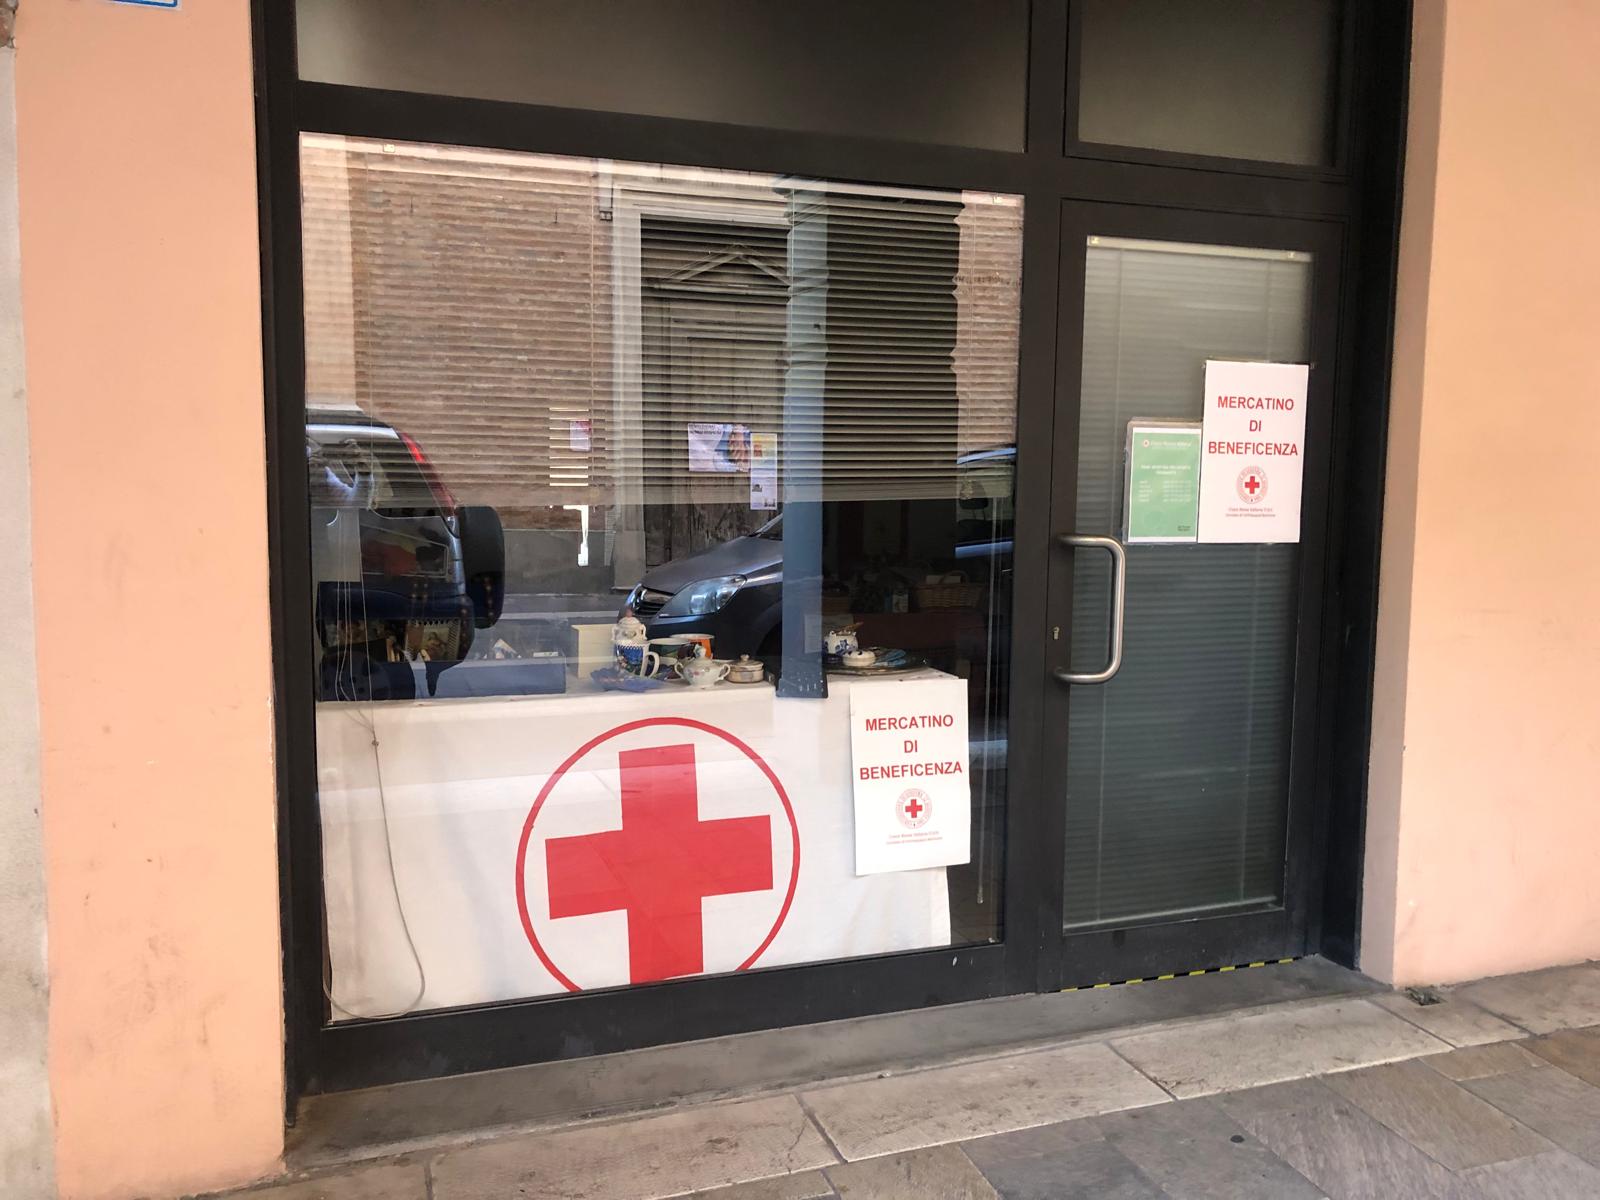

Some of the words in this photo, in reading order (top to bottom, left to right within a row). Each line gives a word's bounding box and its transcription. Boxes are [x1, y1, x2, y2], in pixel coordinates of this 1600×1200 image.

[1217, 395, 1295, 411] MERCATINO
[1249, 419, 1262, 432] DI
[1208, 441, 1298, 456] BENEFICENZA
[865, 714, 954, 731] MERCATINO
[903, 739, 918, 754] DI
[859, 761, 963, 780] BENEFICENZA
